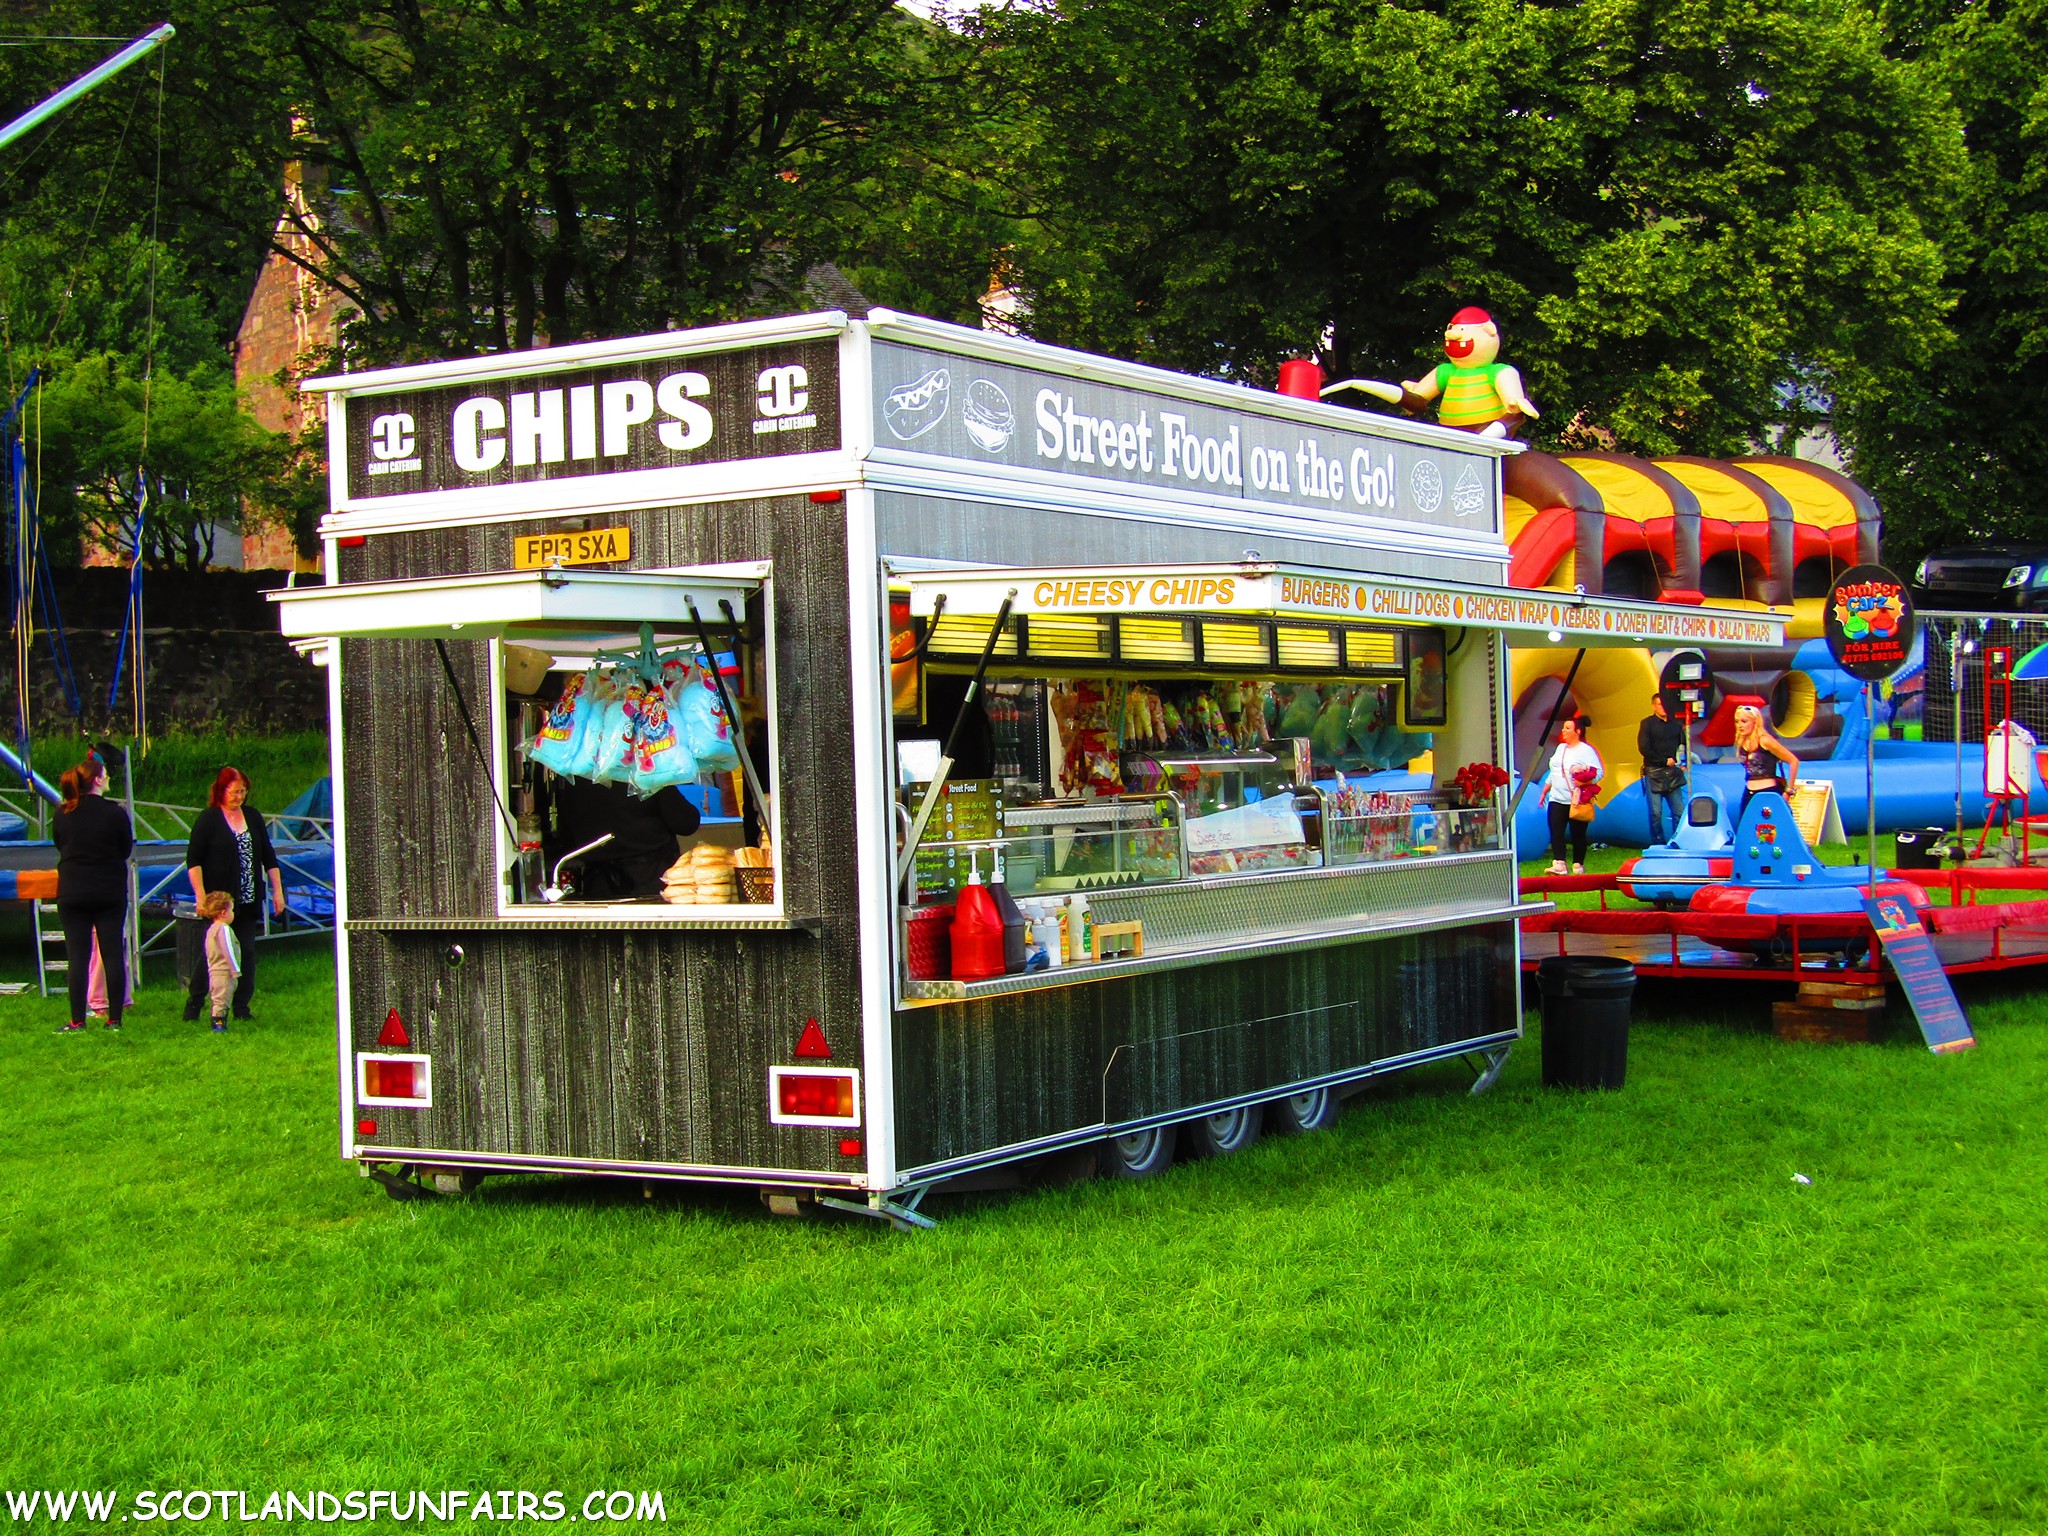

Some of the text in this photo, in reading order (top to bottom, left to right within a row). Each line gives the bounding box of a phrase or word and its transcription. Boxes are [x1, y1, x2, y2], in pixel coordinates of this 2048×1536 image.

[453, 372, 713, 472] CHIPS
[753, 413, 817, 434] CABIN CATERING
[1036, 388, 1395, 509] Street Food on the Go!
[368, 458, 422, 476] CABIN CATERING
[528, 533, 617, 564] FP13 SXA
[1033, 578, 1236, 607] CHEESY CHIPS
[1281, 577, 1771, 643] BURGERS CHILLI DOGS CHICKEN WRAP KEBABS DONER MEAT & CHIPS SALAD WRAPS
[1844, 641, 1900, 653] FOR HIRE
[949, 783, 977, 793] Street Food
